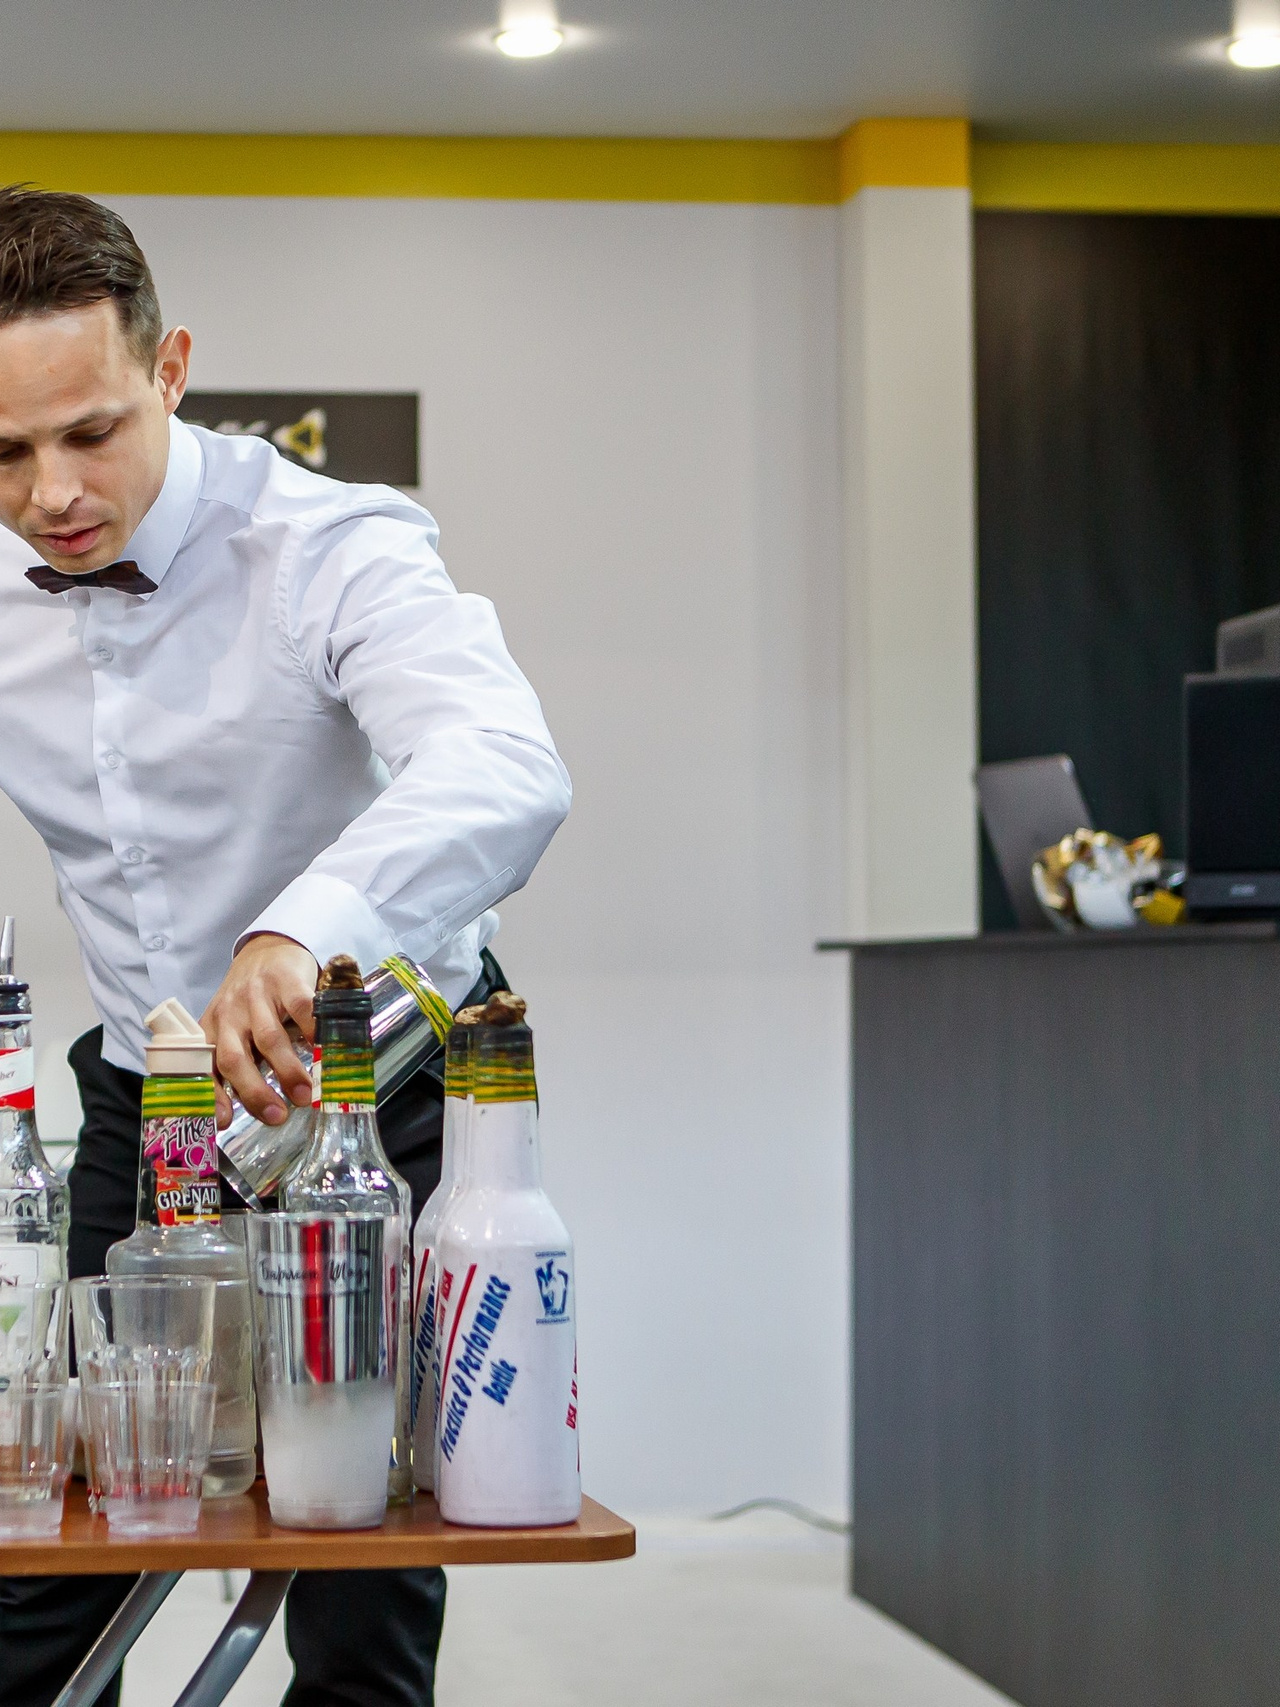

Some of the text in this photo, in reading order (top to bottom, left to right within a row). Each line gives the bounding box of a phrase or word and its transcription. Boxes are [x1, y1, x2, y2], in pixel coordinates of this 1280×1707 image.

[441, 1391, 469, 1464] Practice
[455, 1273, 512, 1383] Performance
[482, 1358, 518, 1407] Bottle
